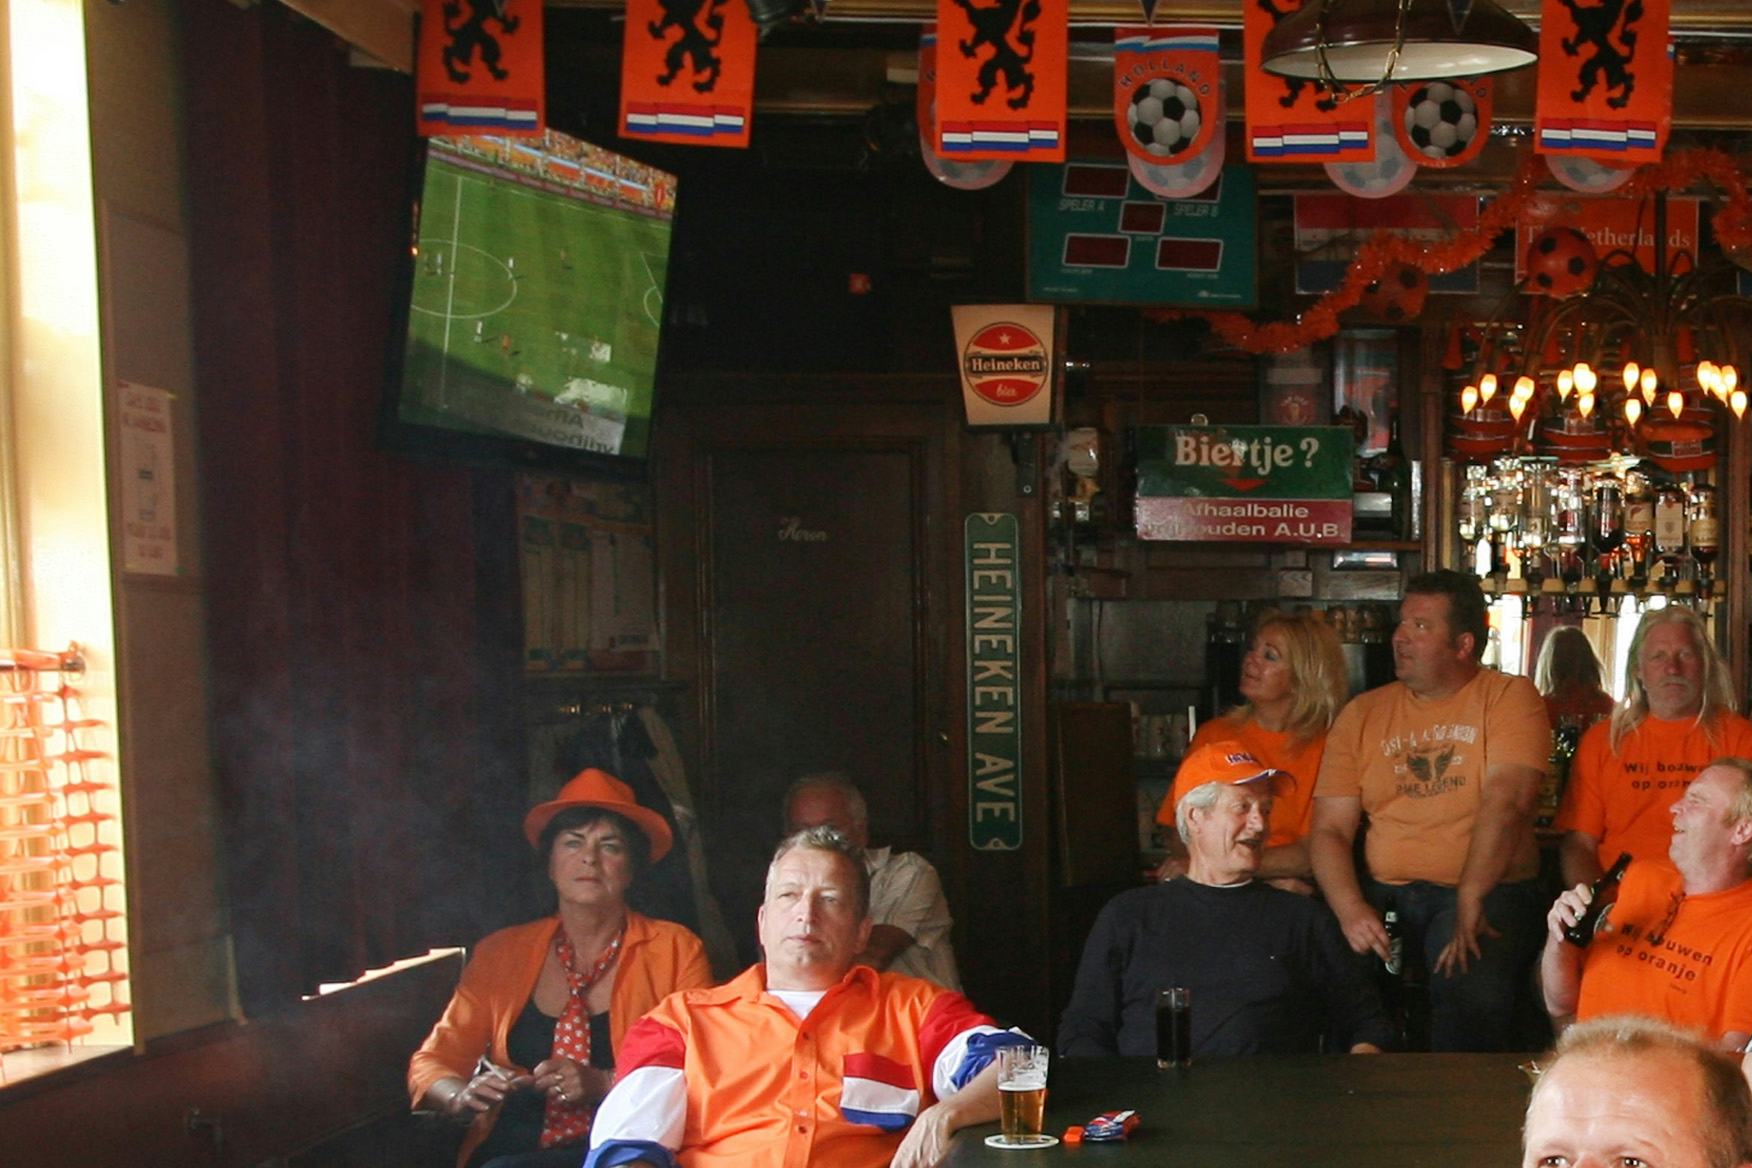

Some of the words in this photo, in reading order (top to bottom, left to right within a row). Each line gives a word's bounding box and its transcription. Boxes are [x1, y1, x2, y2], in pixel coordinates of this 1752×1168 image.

[1119, 60, 1210, 97] HOLLAND
[1581, 226, 1690, 247] etherlads
[971, 357, 1040, 372] Heineken
[1182, 503, 1310, 518] Afhaalbalie
[972, 542, 1014, 734] HEINEKEN
[975, 752, 1016, 823] AVE
[1616, 944, 1632, 959] op
[1639, 951, 1697, 982] oranje
